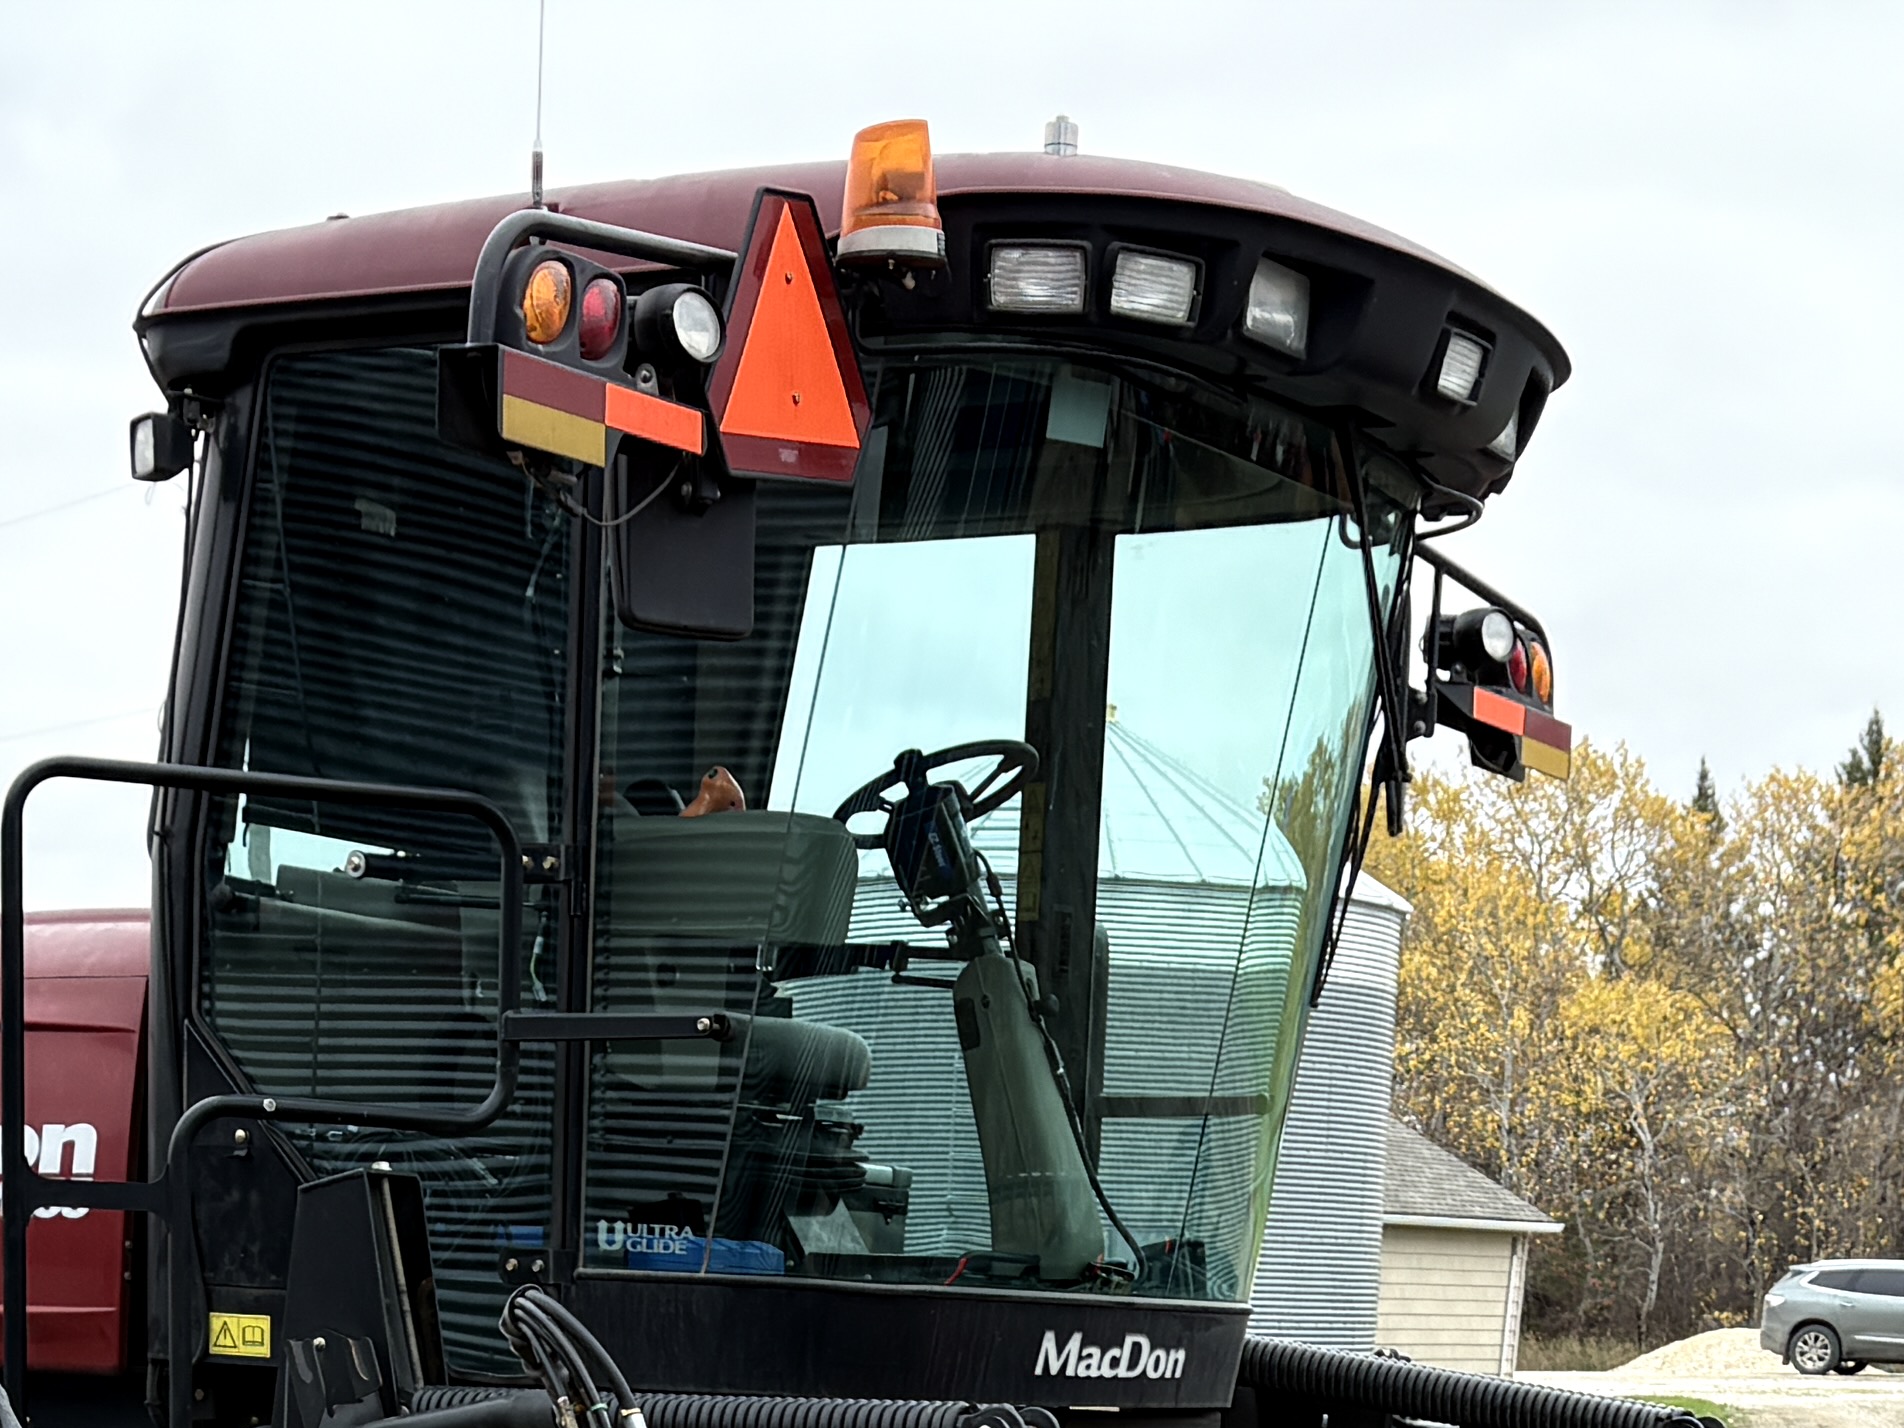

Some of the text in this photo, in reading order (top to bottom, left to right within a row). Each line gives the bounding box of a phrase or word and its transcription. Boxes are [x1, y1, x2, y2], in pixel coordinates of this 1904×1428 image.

[626, 1222, 695, 1240] ULTRA
[626, 1238, 688, 1255] GLIDE
[1034, 1330, 1186, 1379] MacDon
